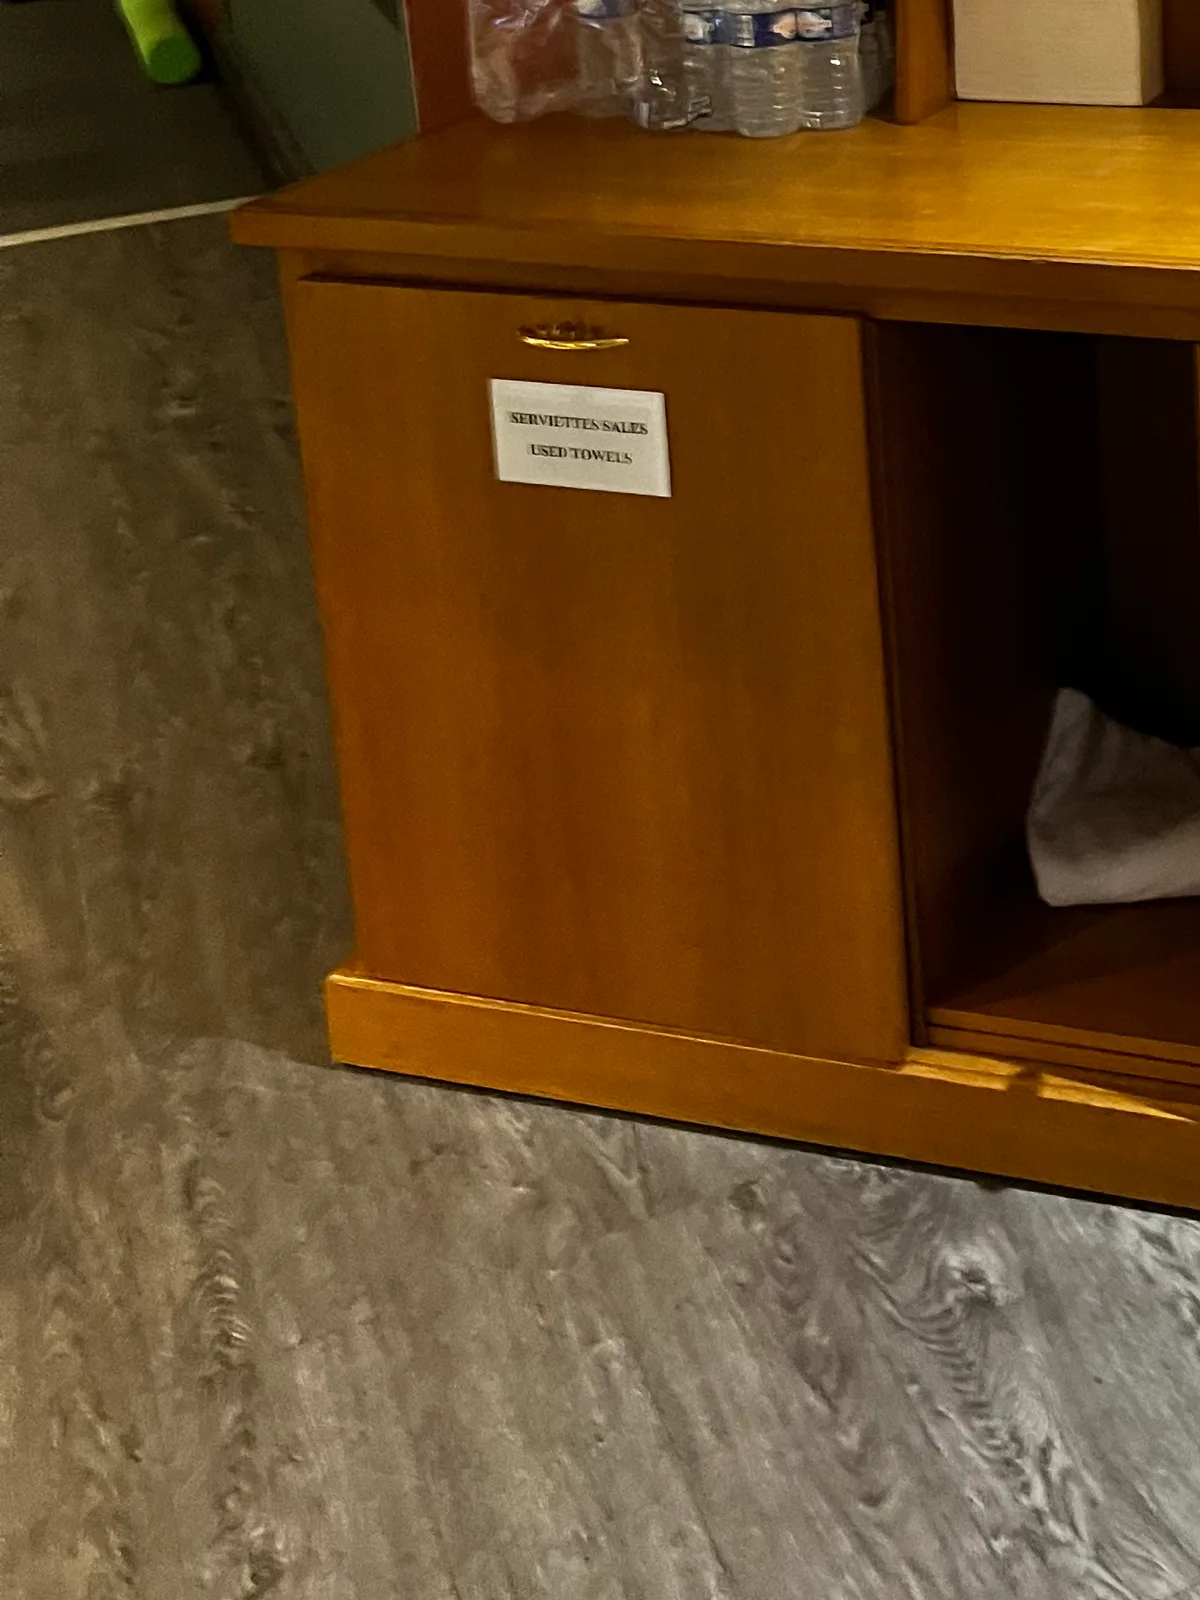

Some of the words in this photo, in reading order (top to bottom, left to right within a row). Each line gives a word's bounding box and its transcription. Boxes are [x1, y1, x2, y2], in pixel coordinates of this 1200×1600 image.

[509, 411, 600, 431] SERVIETTES
[602, 419, 649, 435] SALES
[529, 443, 568, 458] USED
[570, 447, 633, 464] TOWELS
